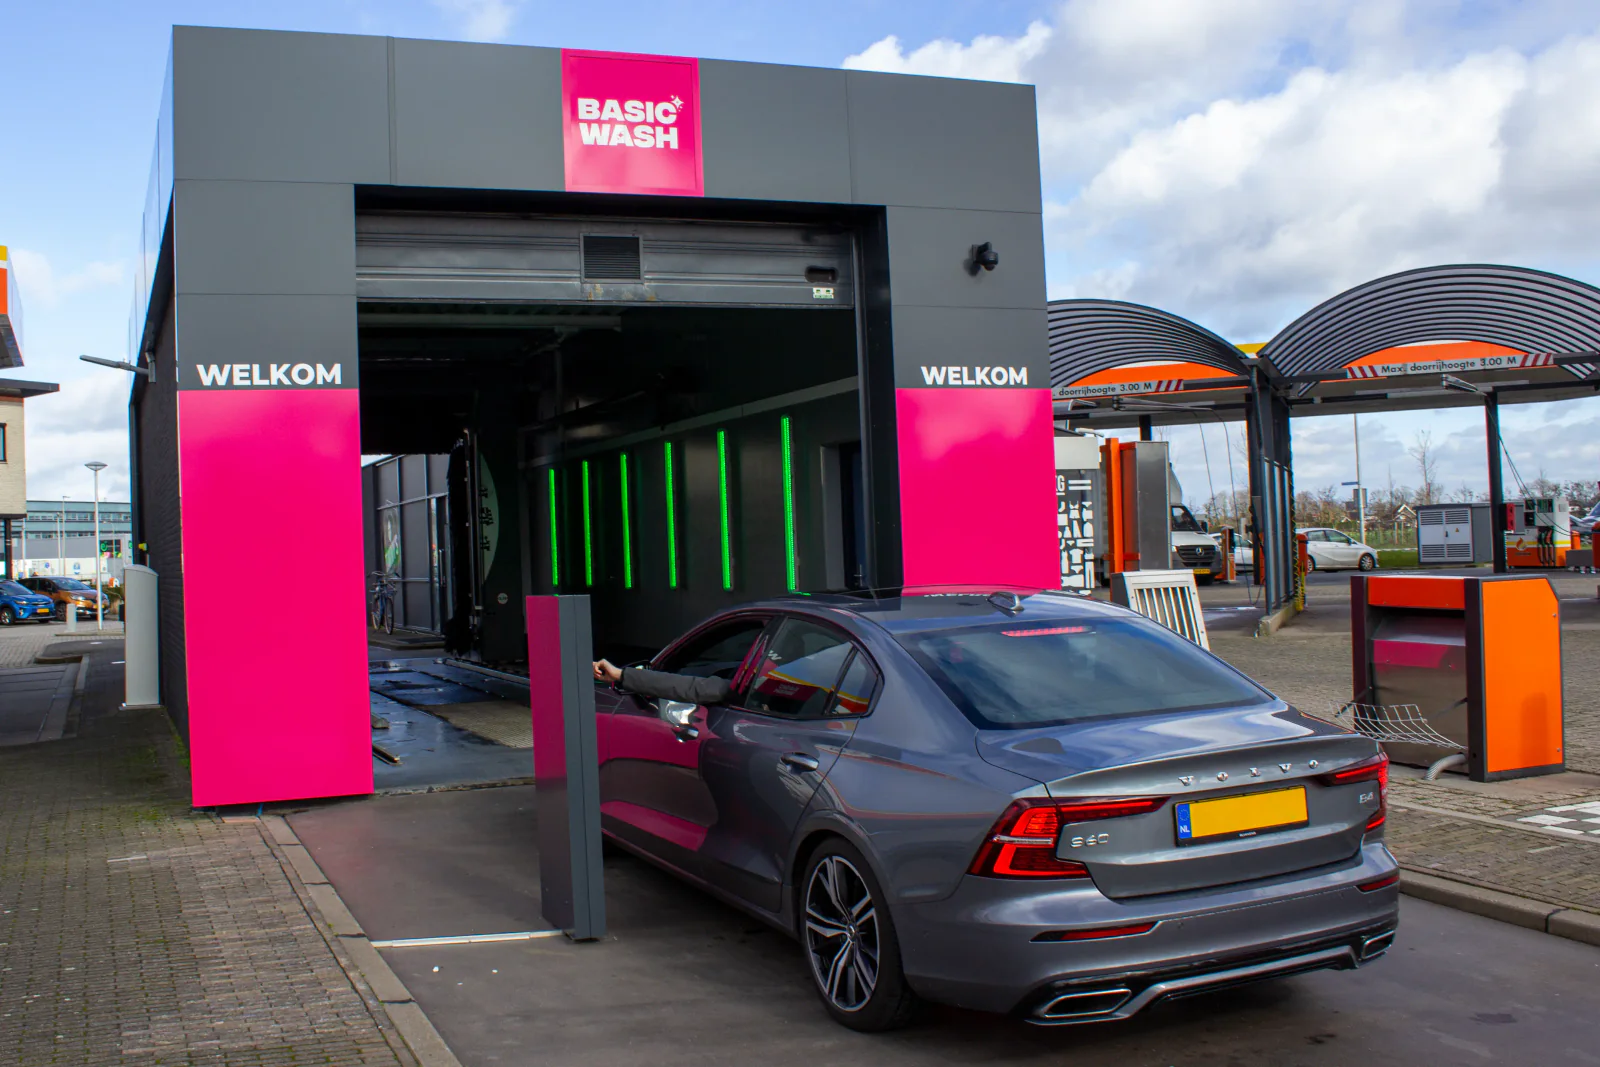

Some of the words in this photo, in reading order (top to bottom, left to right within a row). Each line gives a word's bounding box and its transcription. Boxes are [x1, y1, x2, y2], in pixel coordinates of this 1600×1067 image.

[577, 97, 678, 125] BASIC
[579, 122, 679, 150] WASH
[1410, 360, 1475, 371] doorrijhoogte
[1480, 357, 1502, 367] 3.00
[1507, 356, 1517, 365] M
[196, 363, 342, 387] WELKOM
[920, 366, 1028, 386] WELKOM
[1059, 386, 1116, 396] doorrijhoogte
[1120, 383, 1140, 392] 3.00
[1143, 382, 1153, 390] M
[1178, 759, 1319, 787] VOLVO
[1179, 824, 1191, 834] NL
[1070, 832, 1109, 848] S60
